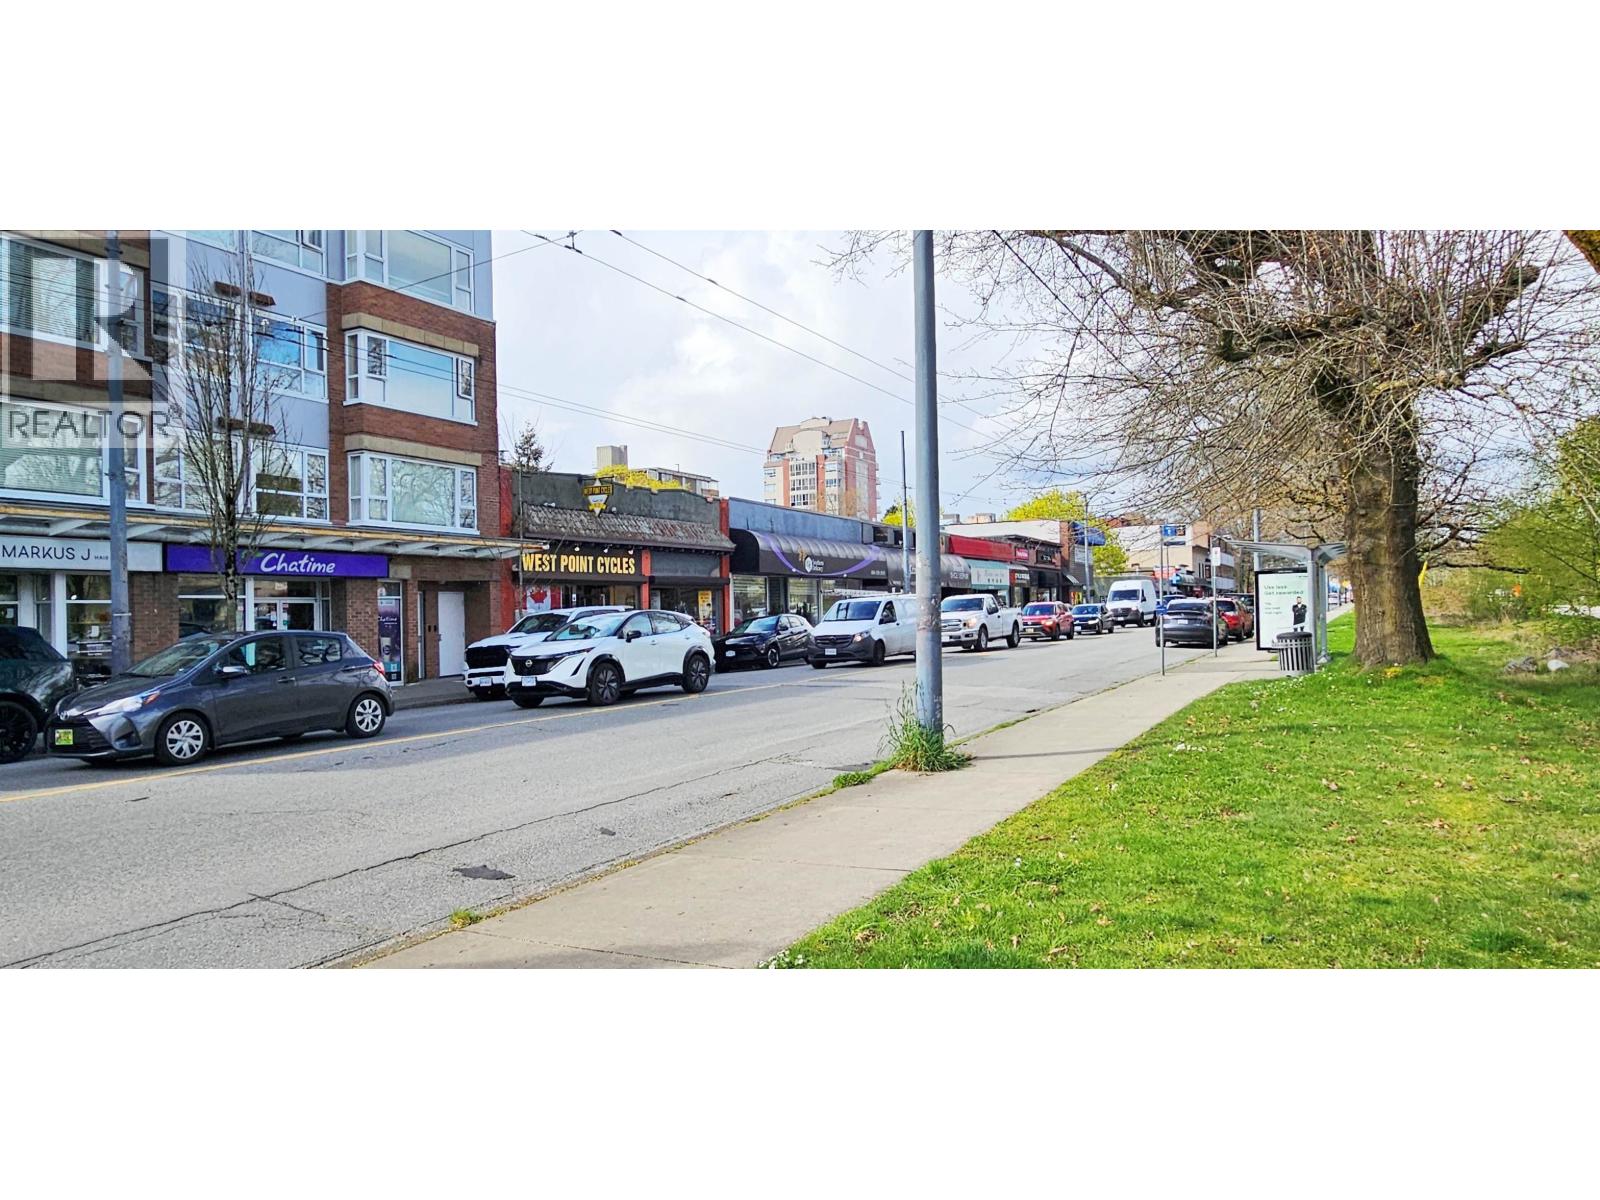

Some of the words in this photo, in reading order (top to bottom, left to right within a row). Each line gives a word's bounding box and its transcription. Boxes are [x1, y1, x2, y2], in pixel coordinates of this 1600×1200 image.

[2, 545, 75, 560] MARKUS
[81, 548, 91, 561] J
[260, 552, 336, 574] Chatime
[522, 553, 557, 572] WEST
[560, 554, 594, 573] POINT
[597, 556, 636, 575] CYCLES
